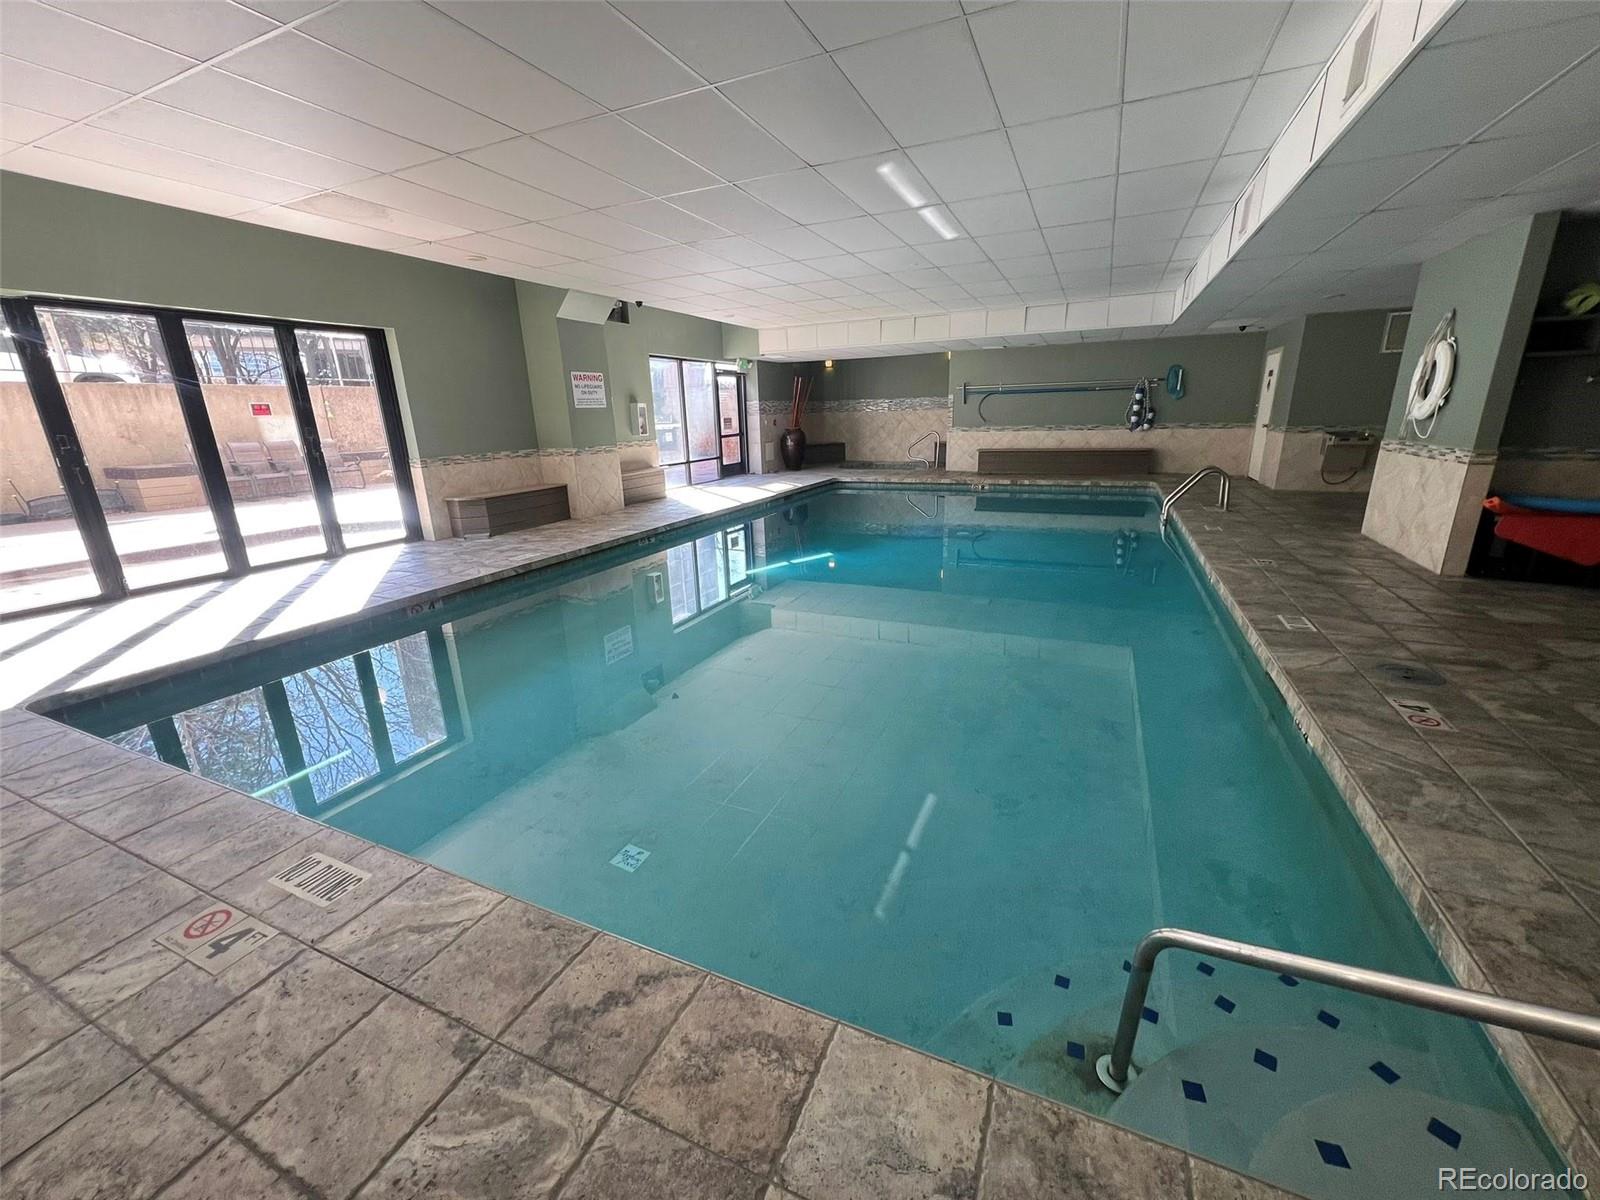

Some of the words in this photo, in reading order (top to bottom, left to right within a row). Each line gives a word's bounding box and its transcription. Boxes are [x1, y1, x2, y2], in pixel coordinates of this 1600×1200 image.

[572, 373, 603, 382] WARNING
[275, 856, 322, 882] NO
[293, 864, 363, 902] DIVING
[206, 927, 255, 959] 4
